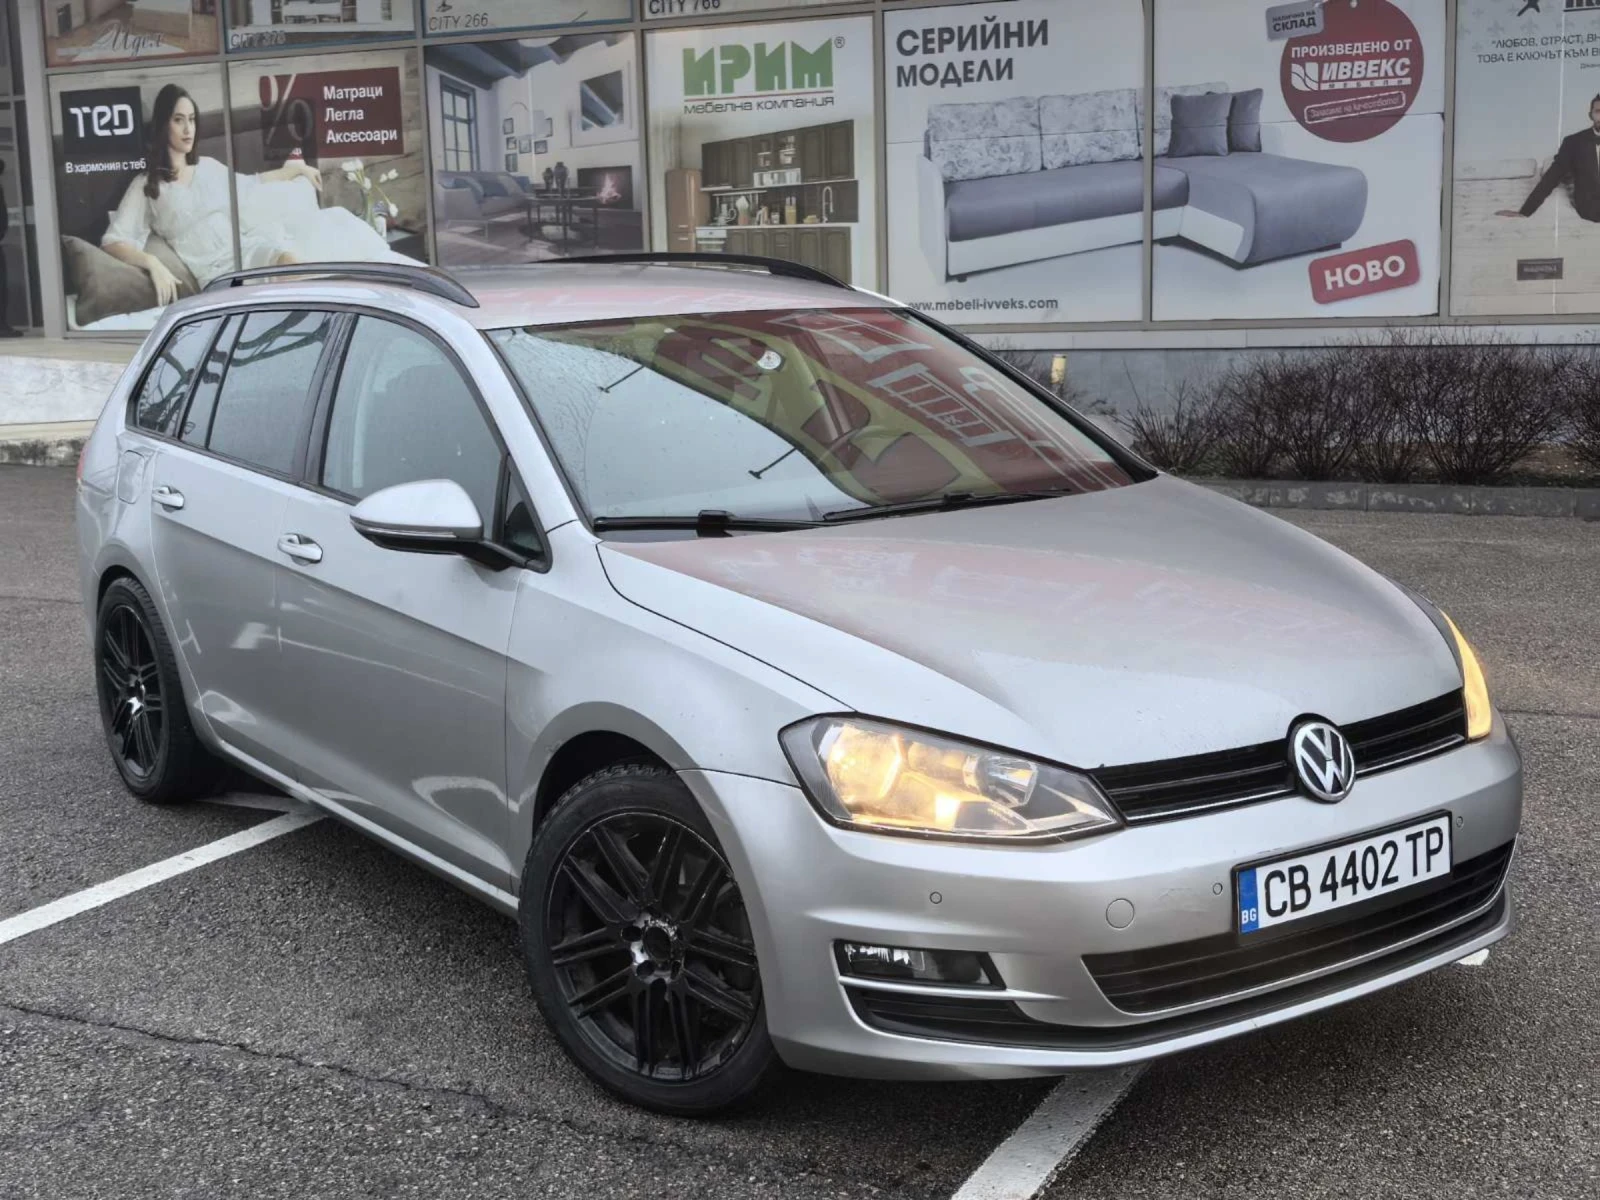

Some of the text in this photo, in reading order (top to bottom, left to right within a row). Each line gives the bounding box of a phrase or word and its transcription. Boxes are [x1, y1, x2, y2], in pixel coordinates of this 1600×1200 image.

[649, 0, 687, 14] CITY
[429, 12, 488, 31] CITY 266
[1273, 17, 1316, 33] СКЛАД
[896, 16, 1049, 57] СЕРИЙНИ
[1291, 39, 1412, 58] ПРОИЗВЕДЕНО ОТ
[1477, 53, 1505, 64] ТОВА
[1507, 52, 1515, 62] Е
[1564, 48, 1589, 58] КЪМ
[682, 37, 834, 96] ИРИМ
[896, 58, 1014, 89] МОДЕЛИ
[1321, 58, 1411, 81] ИВВЕКС
[323, 85, 383, 102] Матраци
[325, 107, 365, 122] Легла
[684, 96, 834, 115] мебелна компания
[326, 129, 398, 145] Аксесоари
[65, 157, 146, 175] В хармония с теб
[1323, 255, 1406, 291] НОВО
[1264, 826, 1444, 918] CB 4402 TP
[1241, 909, 1257, 924] BG
